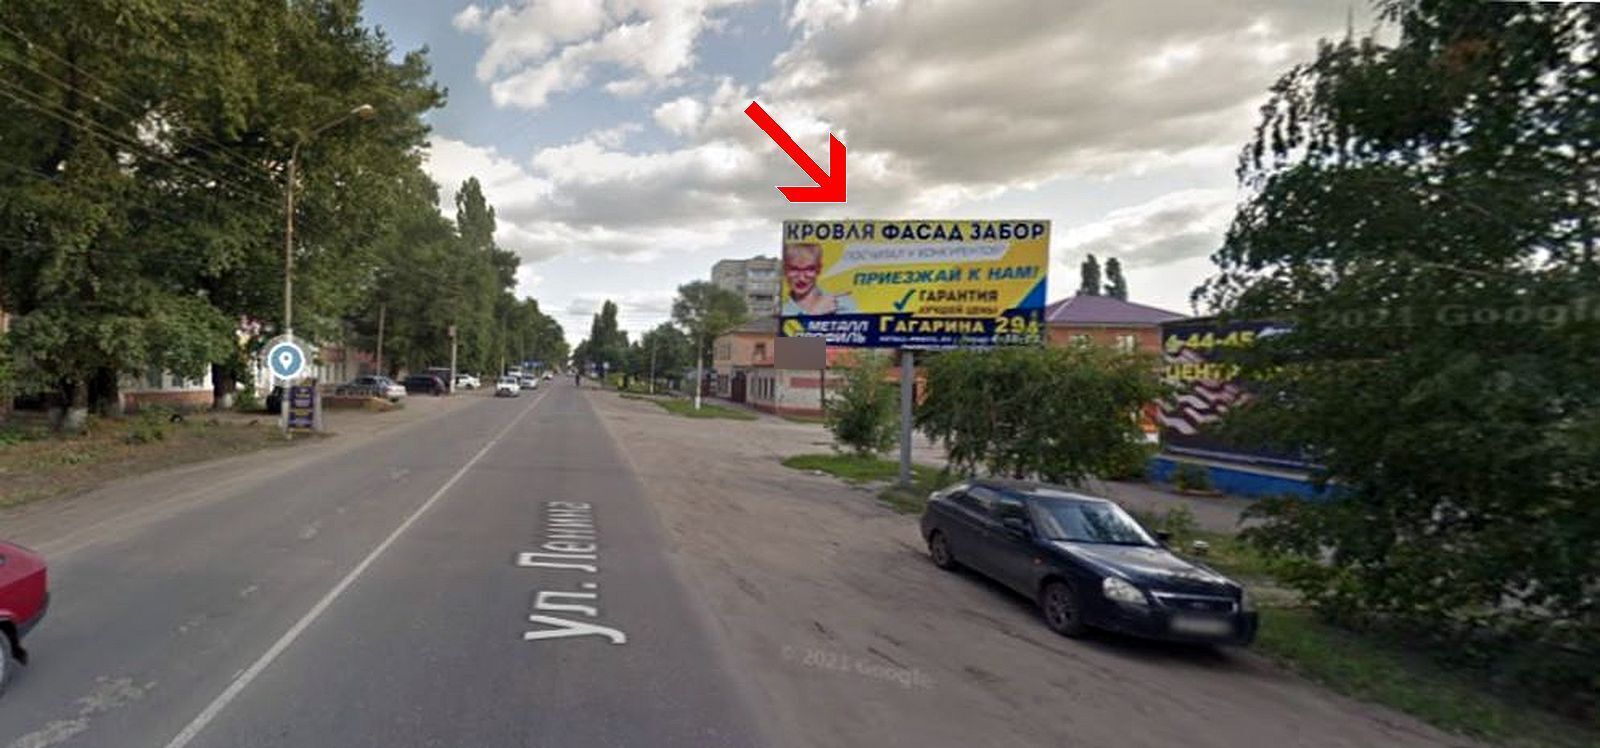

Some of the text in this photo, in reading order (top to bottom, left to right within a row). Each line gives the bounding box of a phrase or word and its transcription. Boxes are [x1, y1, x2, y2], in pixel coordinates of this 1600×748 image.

[786, 223, 1045, 241] КРОВЛЯ ФАСАД ЗАБОР
[852, 265, 1040, 286] ПРИЕЗЖАЙ К НАМ!
[918, 289, 999, 303] ГАРАНТИЯ
[808, 320, 870, 333] МЕТАЛЛ
